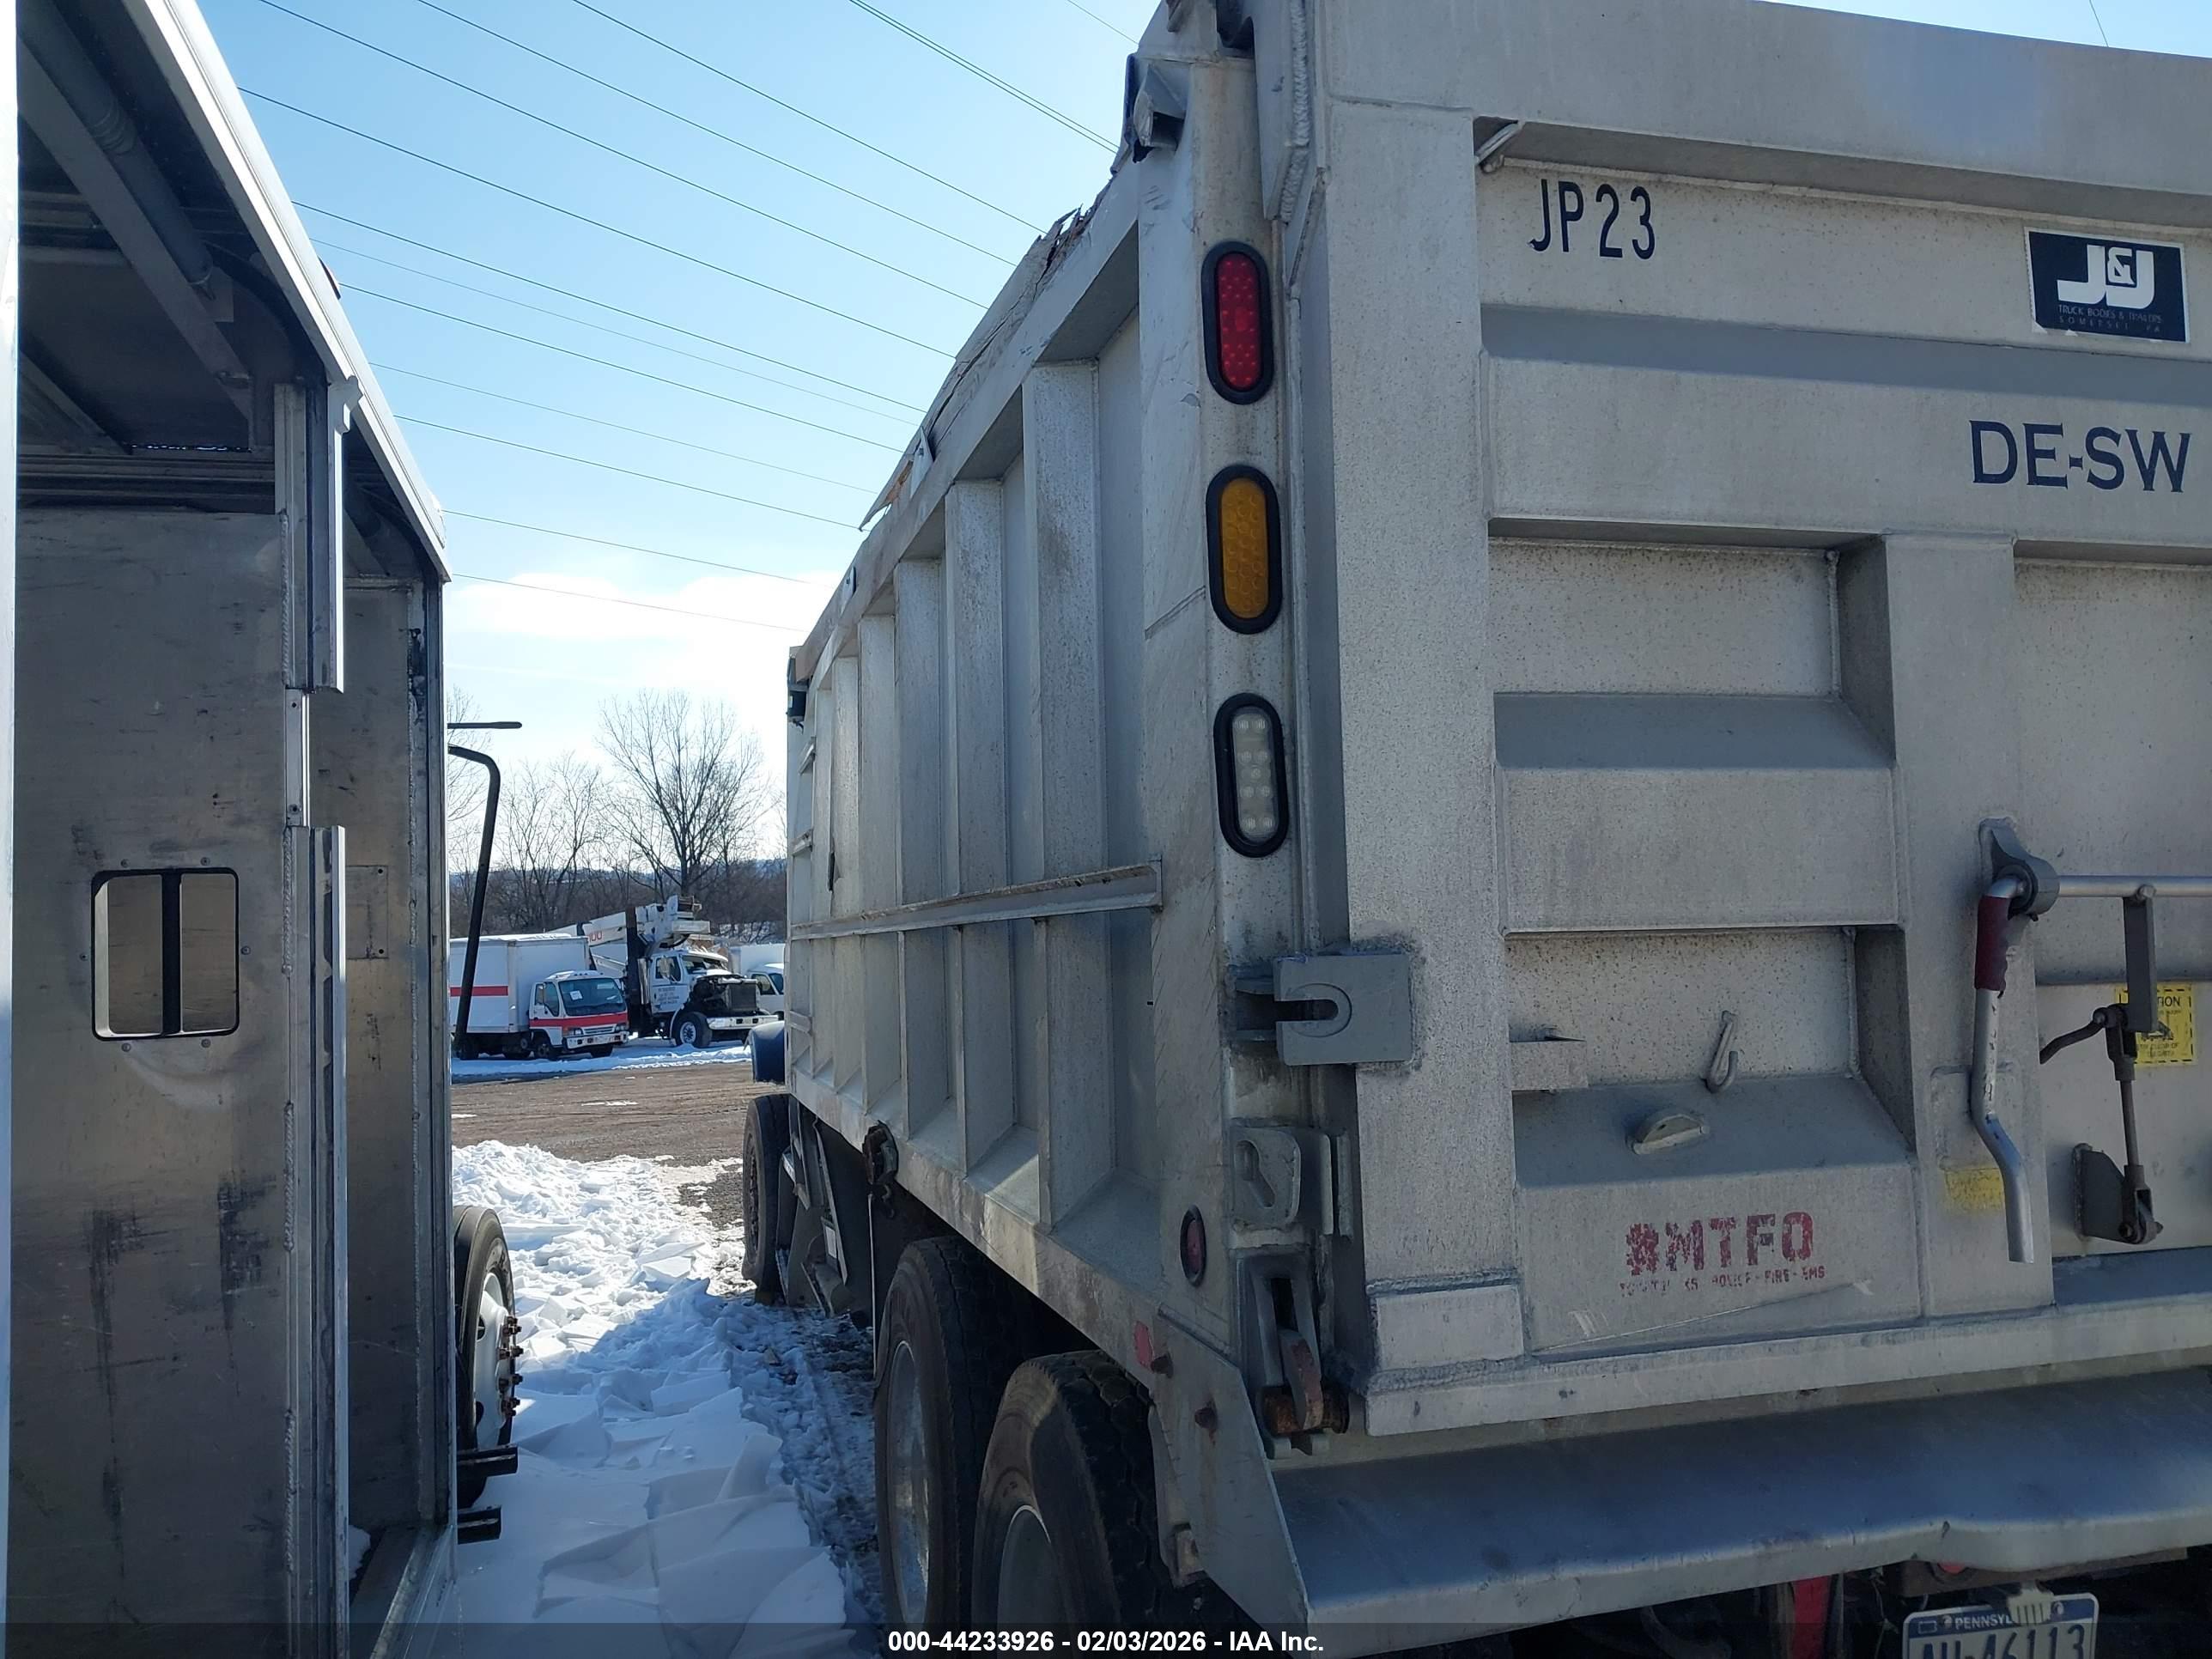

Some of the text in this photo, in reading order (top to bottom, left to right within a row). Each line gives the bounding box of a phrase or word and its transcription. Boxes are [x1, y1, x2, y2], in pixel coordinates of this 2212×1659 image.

[1528, 179, 1656, 260] JP23
[2057, 245, 2155, 310] J&J
[2058, 304, 2084, 315] TRUCK
[2087, 307, 2116, 319] BODIES
[1969, 419, 2191, 494] DE-SW
[2157, 996, 2181, 1007] TION
[1954, 1613, 2014, 1631] PENNSYL
